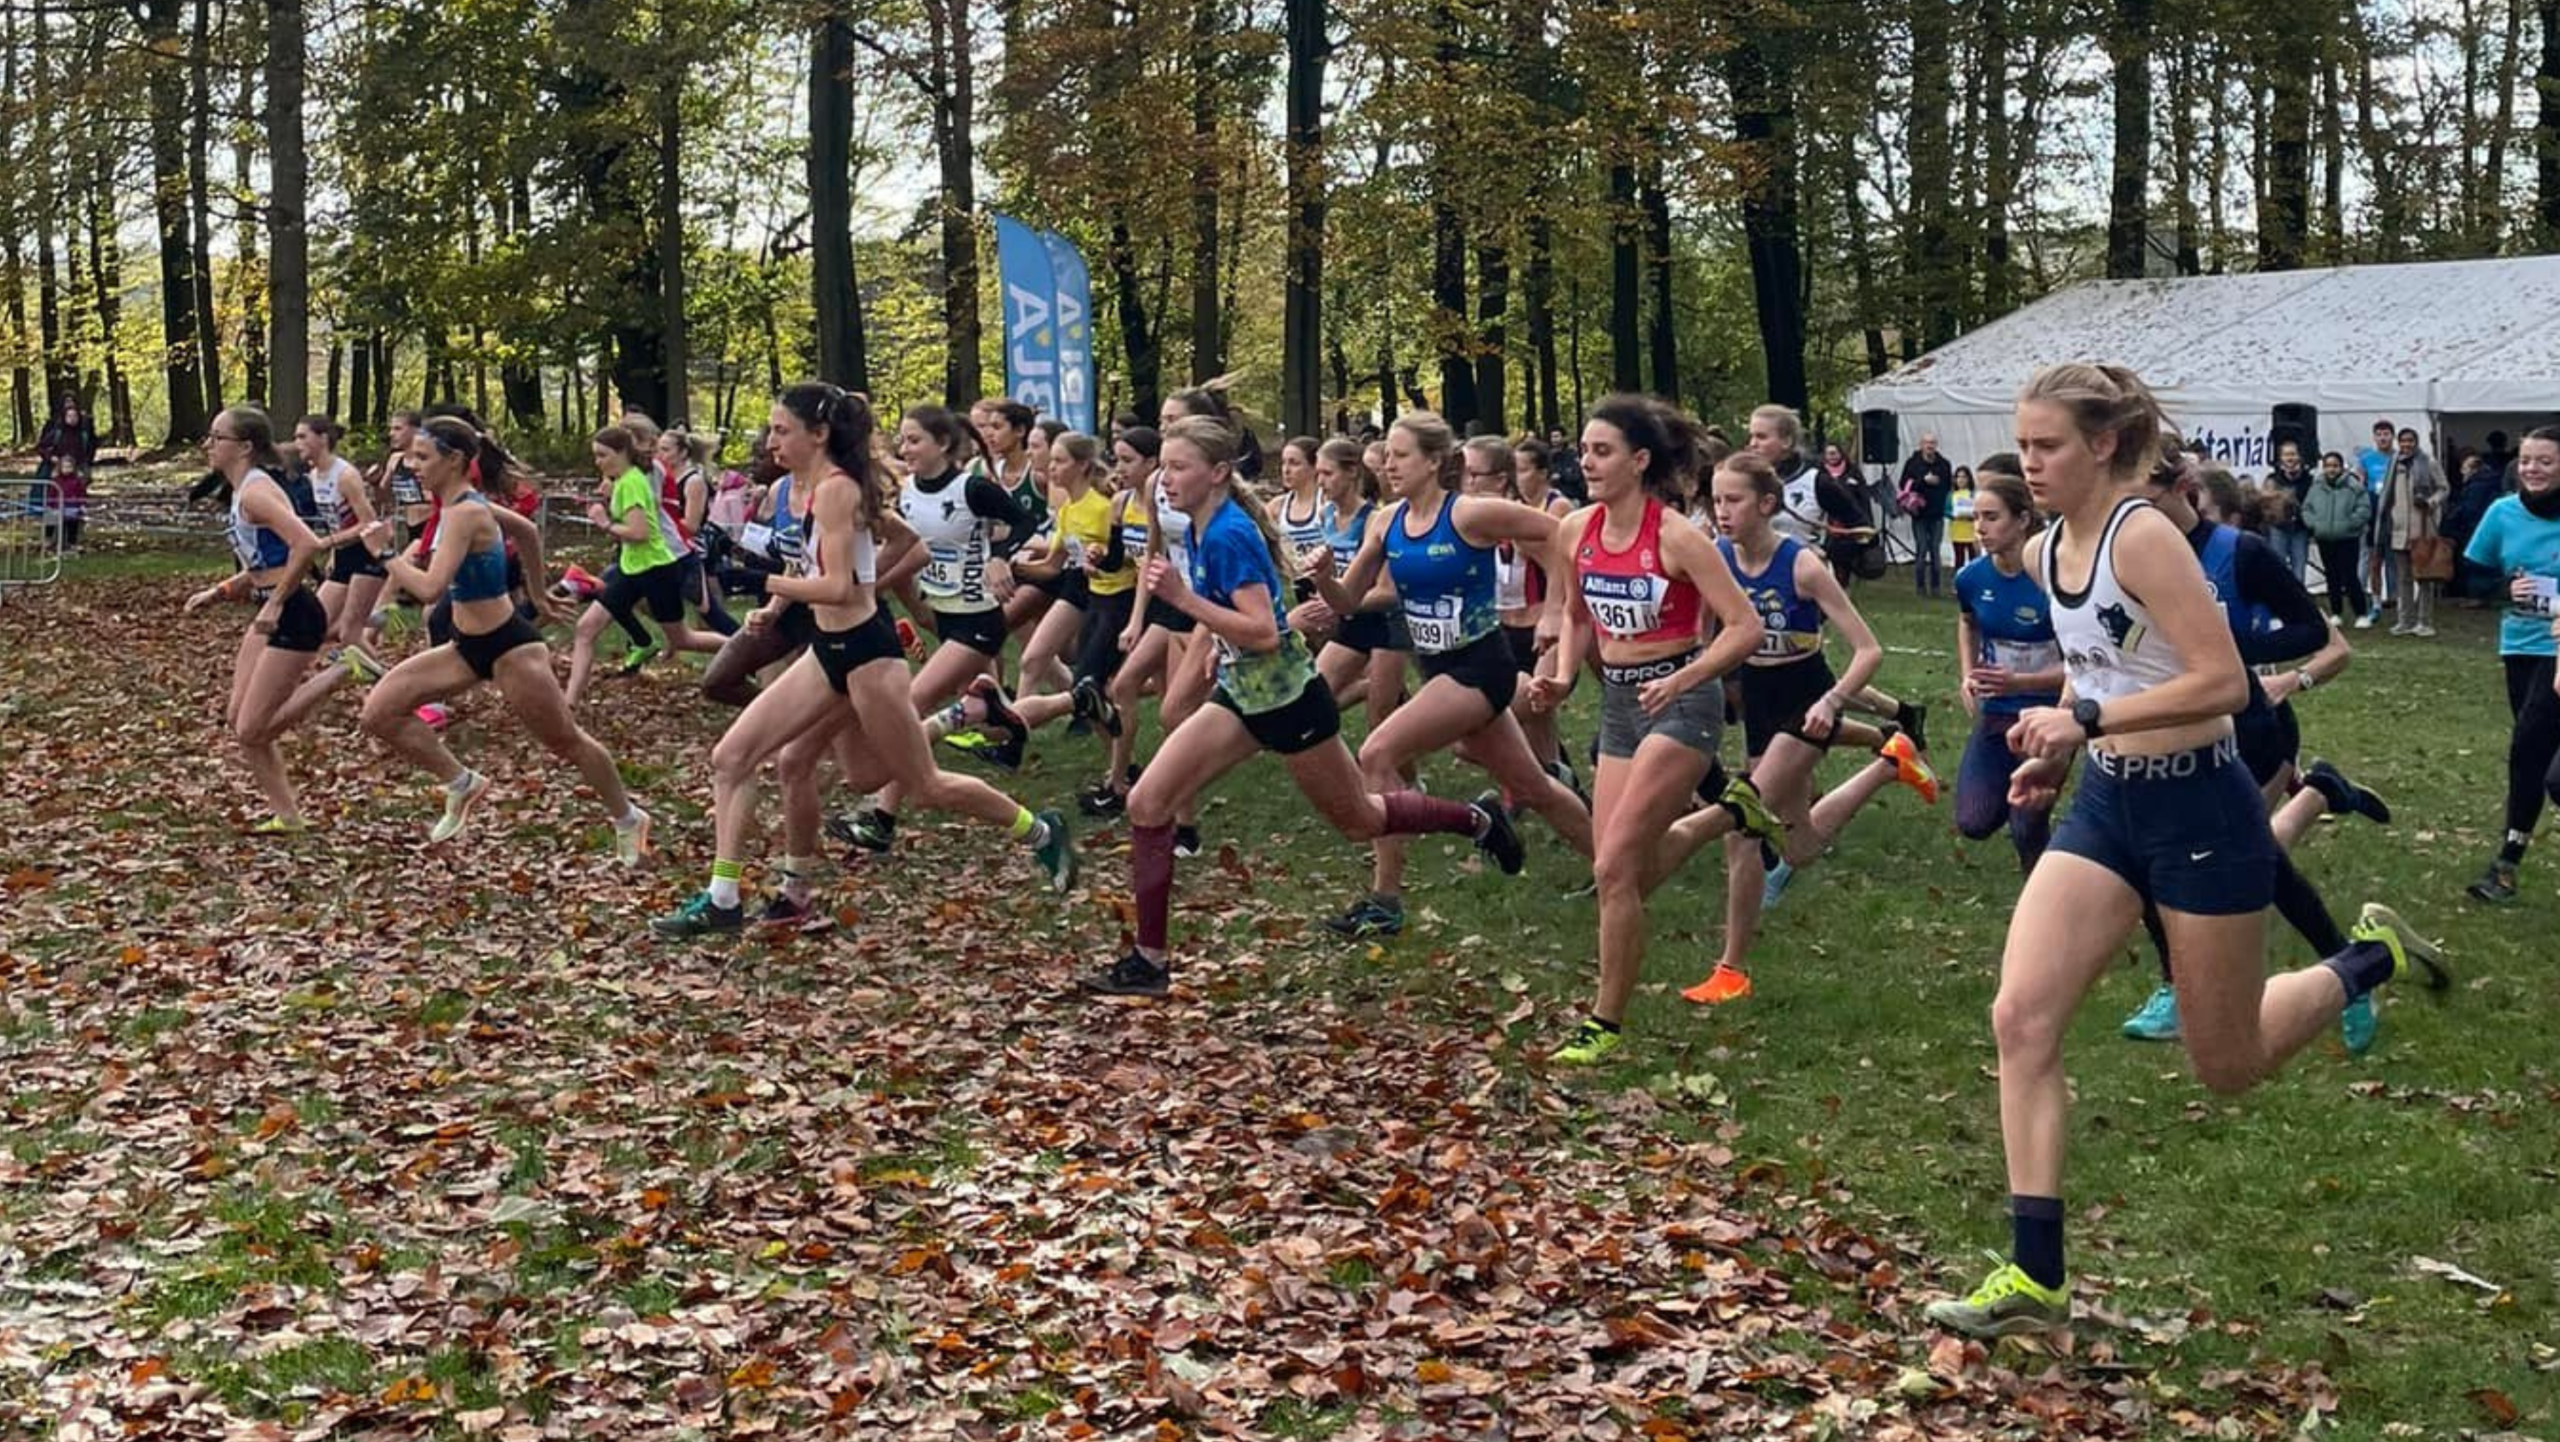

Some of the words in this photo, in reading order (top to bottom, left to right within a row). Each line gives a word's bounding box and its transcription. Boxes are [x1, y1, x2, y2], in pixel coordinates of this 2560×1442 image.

[1585, 576, 1627, 595] Allianz
[1592, 603, 1637, 628] 1361
[1624, 661, 1676, 682] PRO
[2123, 751, 2198, 780] PRO
